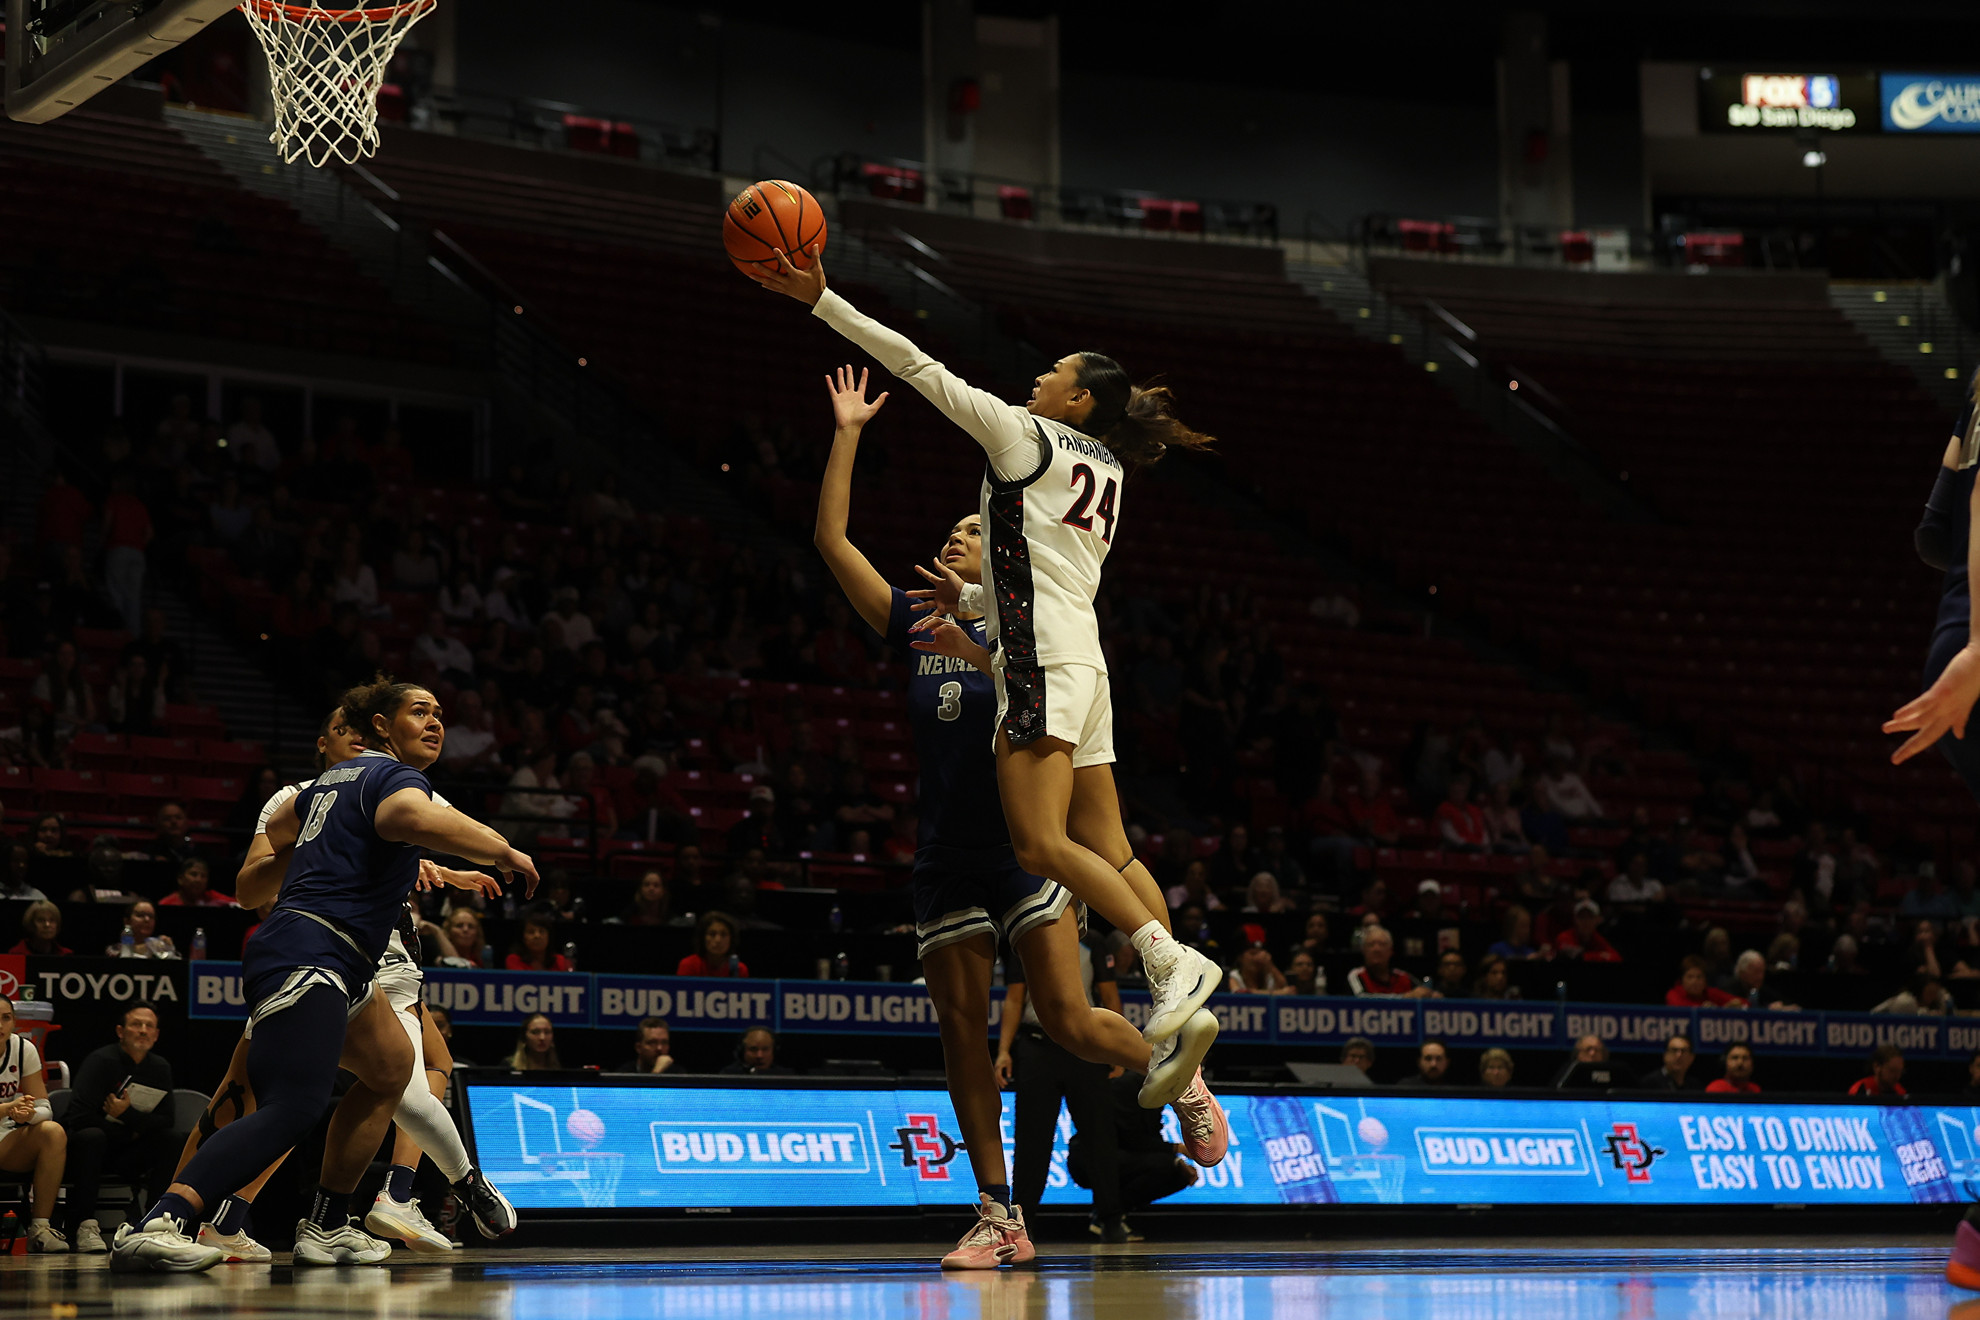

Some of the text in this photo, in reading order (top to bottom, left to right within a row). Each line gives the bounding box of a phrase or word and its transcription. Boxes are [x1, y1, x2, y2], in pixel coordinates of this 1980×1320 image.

[1745, 75, 1807, 108] FOX
[1760, 106, 1798, 127] San
[1798, 106, 1856, 131] Diego
[1062, 463, 1117, 545] 24
[937, 681, 962, 721] 3
[295, 790, 338, 848] 13
[38, 972, 178, 1001] TOYOTA
[484, 984, 585, 1014] LIGHT
[601, 988, 771, 1020] BUD LIGHT
[784, 993, 851, 1021] BUD
[1278, 1007, 1415, 1036] BUD LIGHT
[1424, 1010, 1555, 1039] BUD LIGHT
[1566, 1014, 1690, 1043] BUD LIGHT
[1700, 1017, 1818, 1046] BUD LIGHT
[1826, 1021, 1939, 1050] BUD LIGHT
[1948, 1026, 1980, 1050] BU
[661, 1132, 855, 1163] BUD LIGHT
[1265, 1132, 1314, 1163] BUD
[1678, 1115, 1878, 1153] EASY TO DRINK
[1423, 1137, 1577, 1166] BUD LIGHT
[1896, 1139, 1935, 1167] BUD
[1269, 1153, 1326, 1185] LIGHT
[1689, 1154, 1886, 1191] EASY TO ENJOY
[1901, 1156, 1948, 1187] LIGHT
